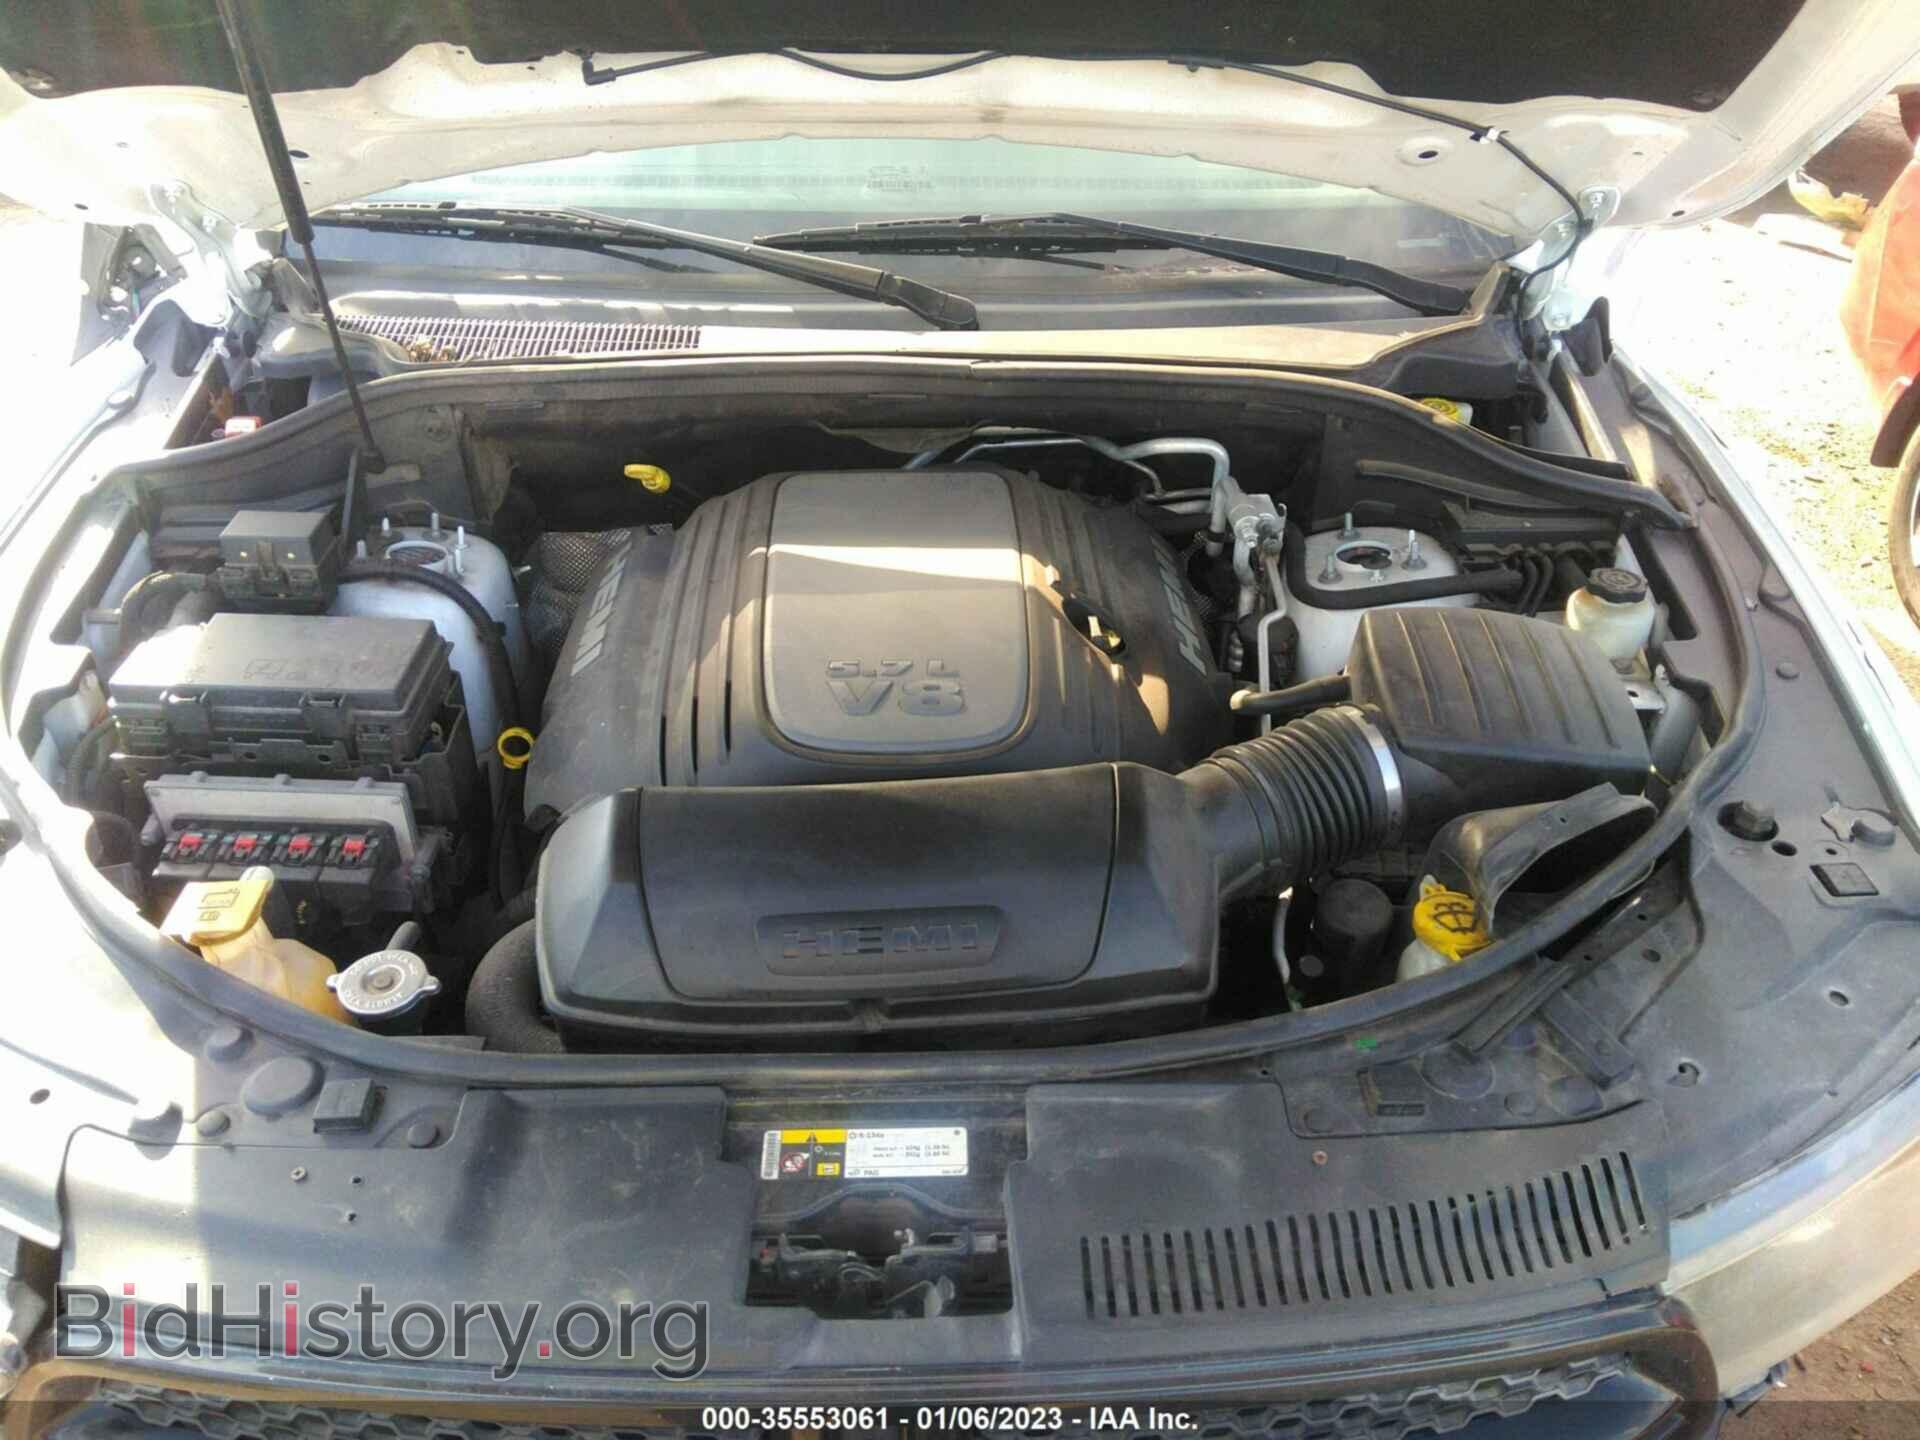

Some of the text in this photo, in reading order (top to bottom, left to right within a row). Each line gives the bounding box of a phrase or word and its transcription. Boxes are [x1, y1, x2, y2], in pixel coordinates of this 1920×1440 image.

[569, 540, 633, 677] HEMI
[1150, 534, 1207, 677] HEMI
[825, 679, 967, 717] V8
[783, 921, 978, 959] HEMI
